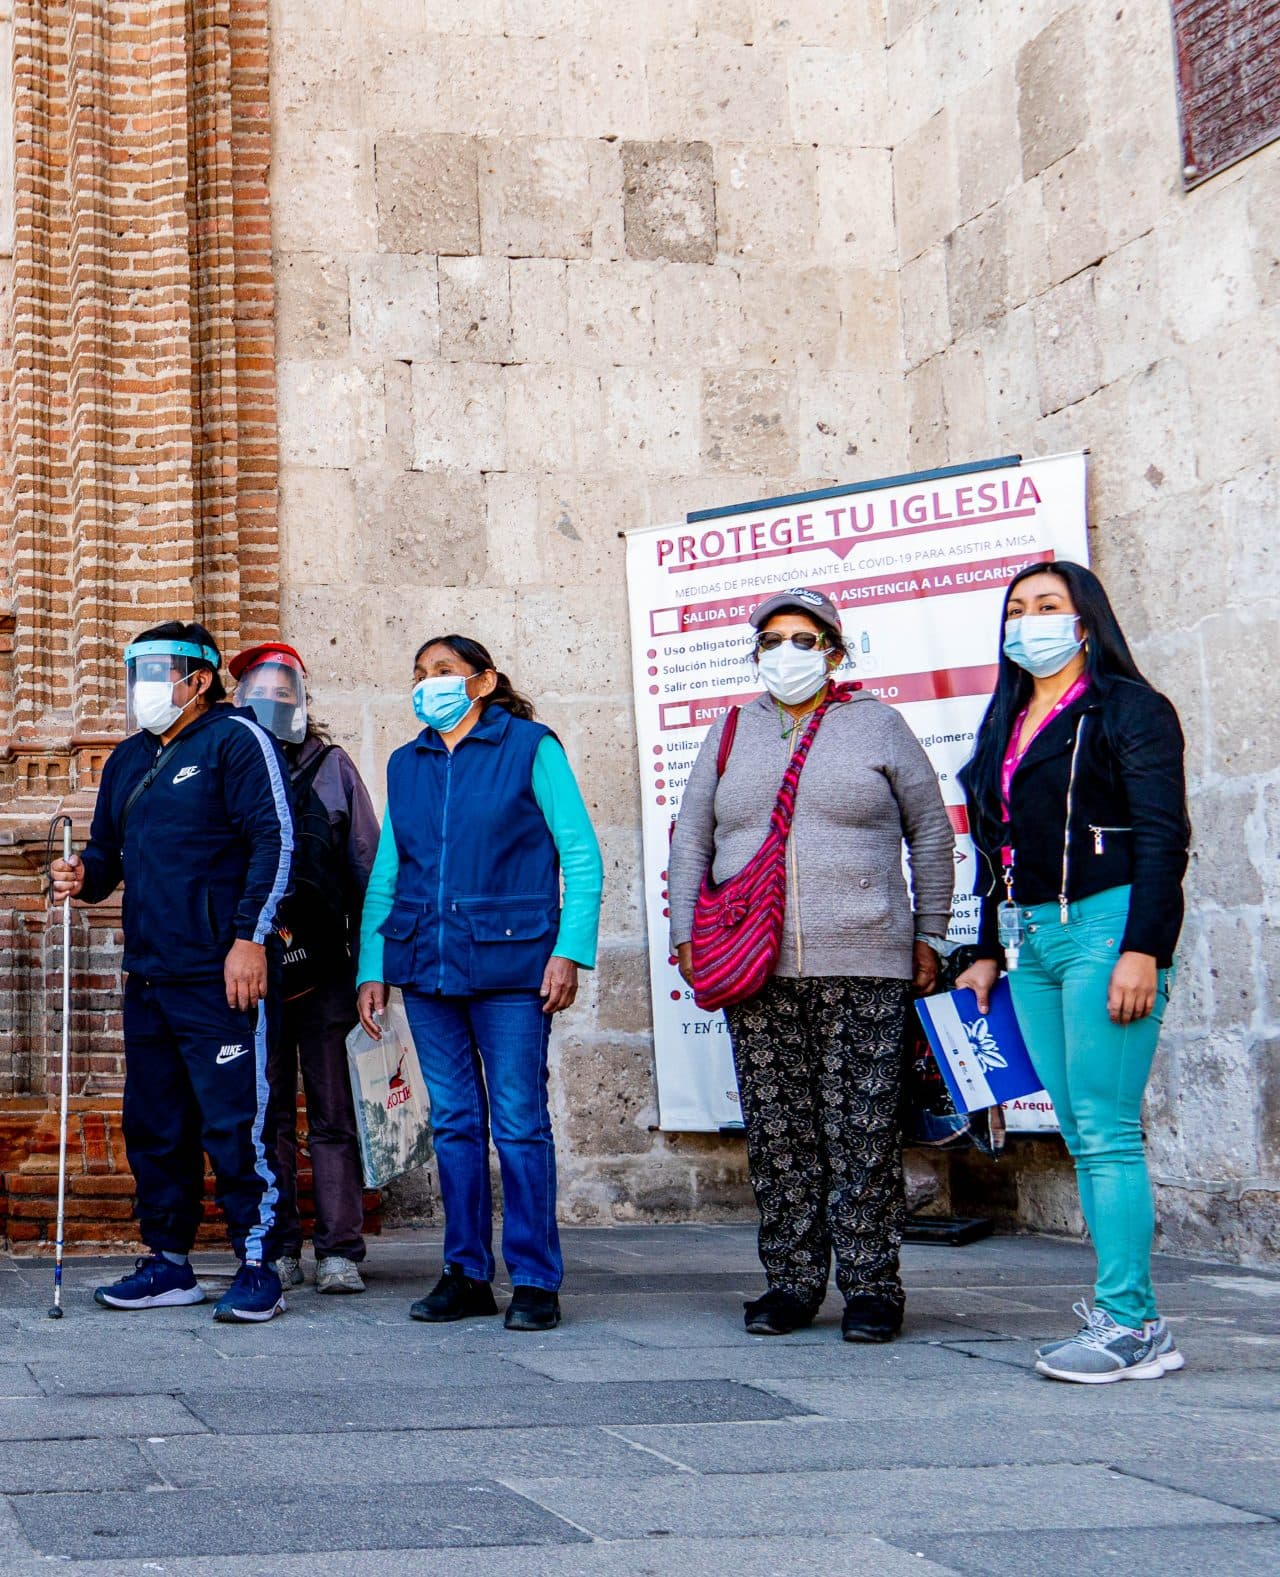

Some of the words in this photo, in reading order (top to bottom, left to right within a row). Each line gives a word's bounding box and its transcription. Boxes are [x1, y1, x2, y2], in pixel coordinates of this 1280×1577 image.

[656, 514, 815, 566] PROTEGE
[825, 503, 875, 537] TU
[889, 476, 1042, 527] IGLESIA
[675, 582, 721, 598] MEDIDAS
[724, 580, 738, 591] DE
[740, 567, 809, 588] PREVENCIÓN
[812, 562, 840, 576] ANTE
[843, 562, 856, 572] EL
[859, 554, 912, 570] COVID-19
[915, 547, 946, 561] PARA
[949, 540, 992, 556] ASISTIR
[995, 540, 1003, 549] A
[1006, 534, 1037, 547] MISA
[683, 610, 727, 625] SALIDA
[729, 605, 746, 617] DE
[749, 602, 762, 613] C
[840, 580, 919, 601] ASISTENCIA
[921, 579, 932, 590] A
[934, 574, 953, 587] LA
[664, 646, 686, 656] Uso
[689, 636, 753, 651] obligatorio
[663, 660, 707, 675] Solución
[664, 682, 687, 693] Salir
[690, 680, 709, 689] con
[712, 673, 751, 686] tiempo
[695, 705, 743, 720] ENTR
[868, 686, 899, 698] PLO
[670, 796, 679, 806] Si
[682, 1022, 691, 1035] Y
[693, 1019, 715, 1035] EN
[220, 1044, 243, 1057] NIKE
